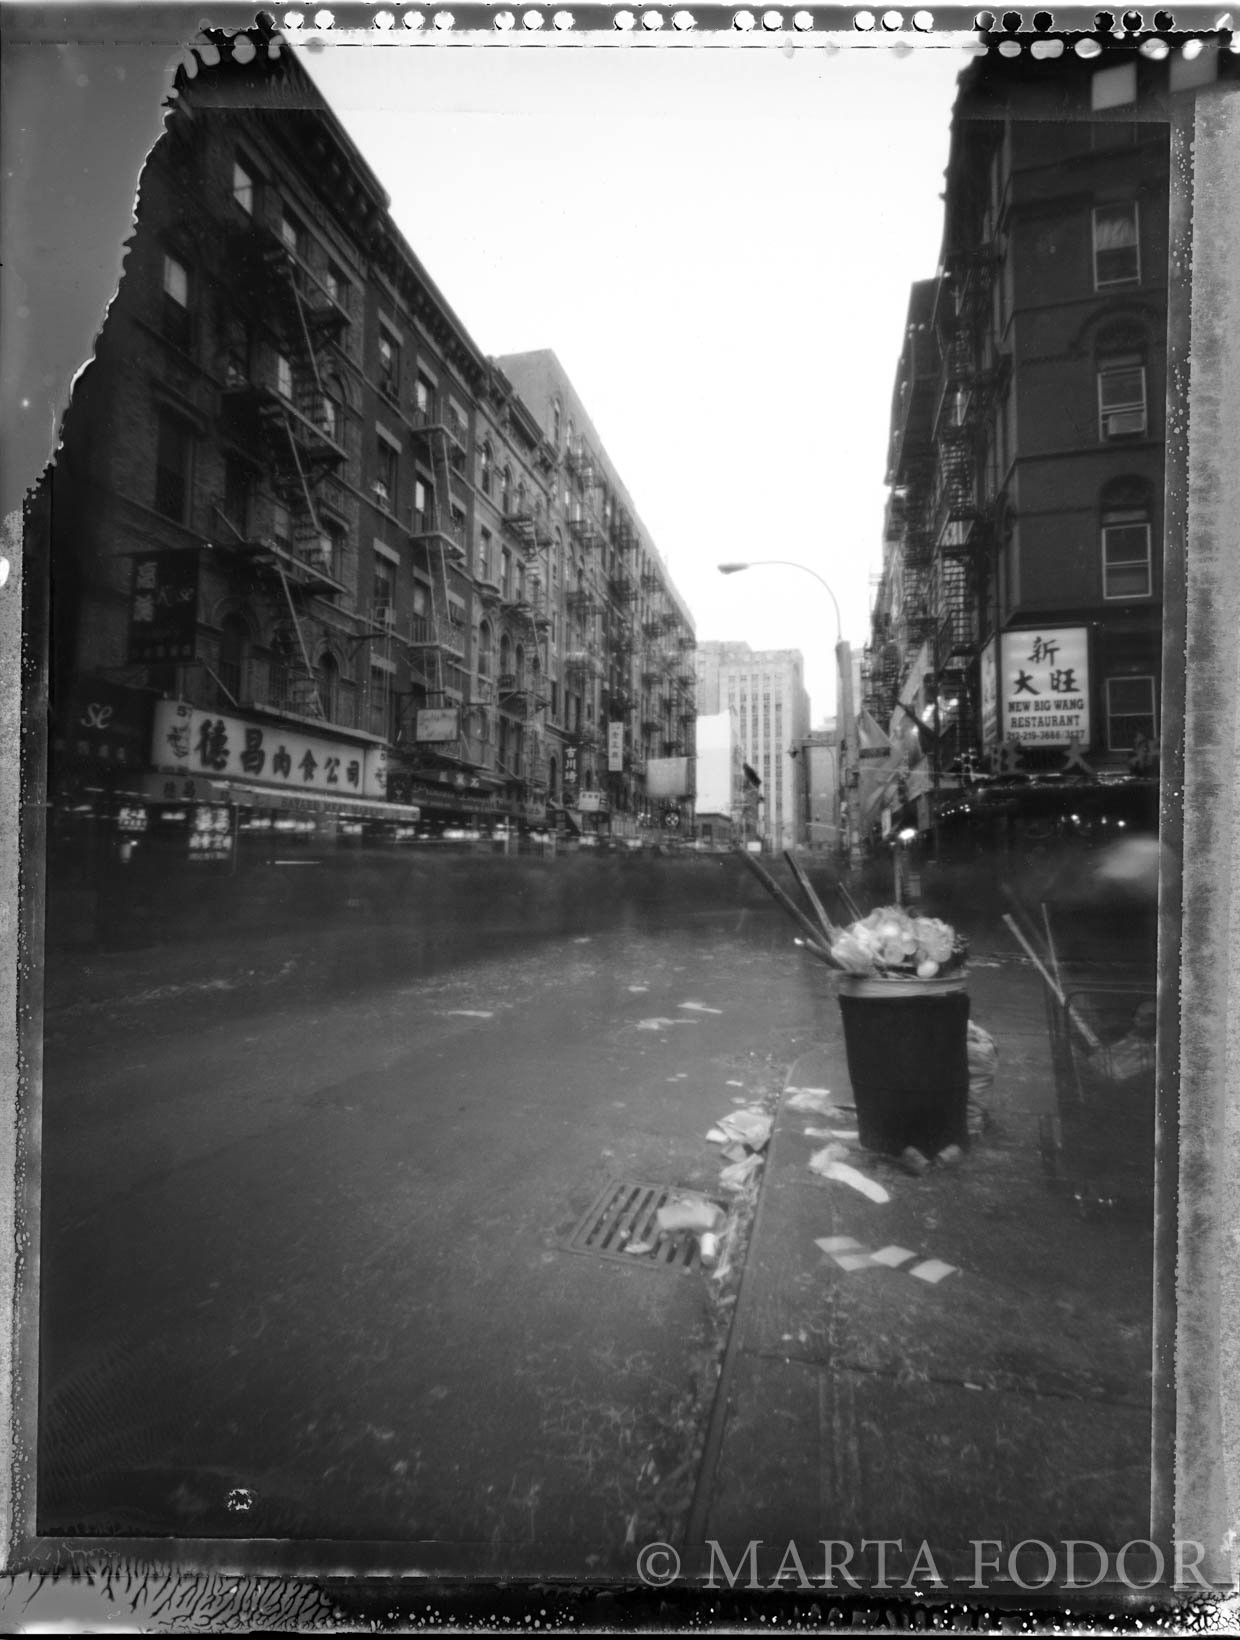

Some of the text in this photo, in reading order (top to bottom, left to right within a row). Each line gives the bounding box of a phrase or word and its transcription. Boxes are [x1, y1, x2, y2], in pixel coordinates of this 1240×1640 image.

[1027, 636, 1061, 667] 新
[1013, 668, 1081, 695] 大旺
[1008, 698, 1085, 713] NEW BIG WANG
[1011, 714, 1081, 729] RESTAURANT
[194, 719, 360, 789] 德昌肉食公司
